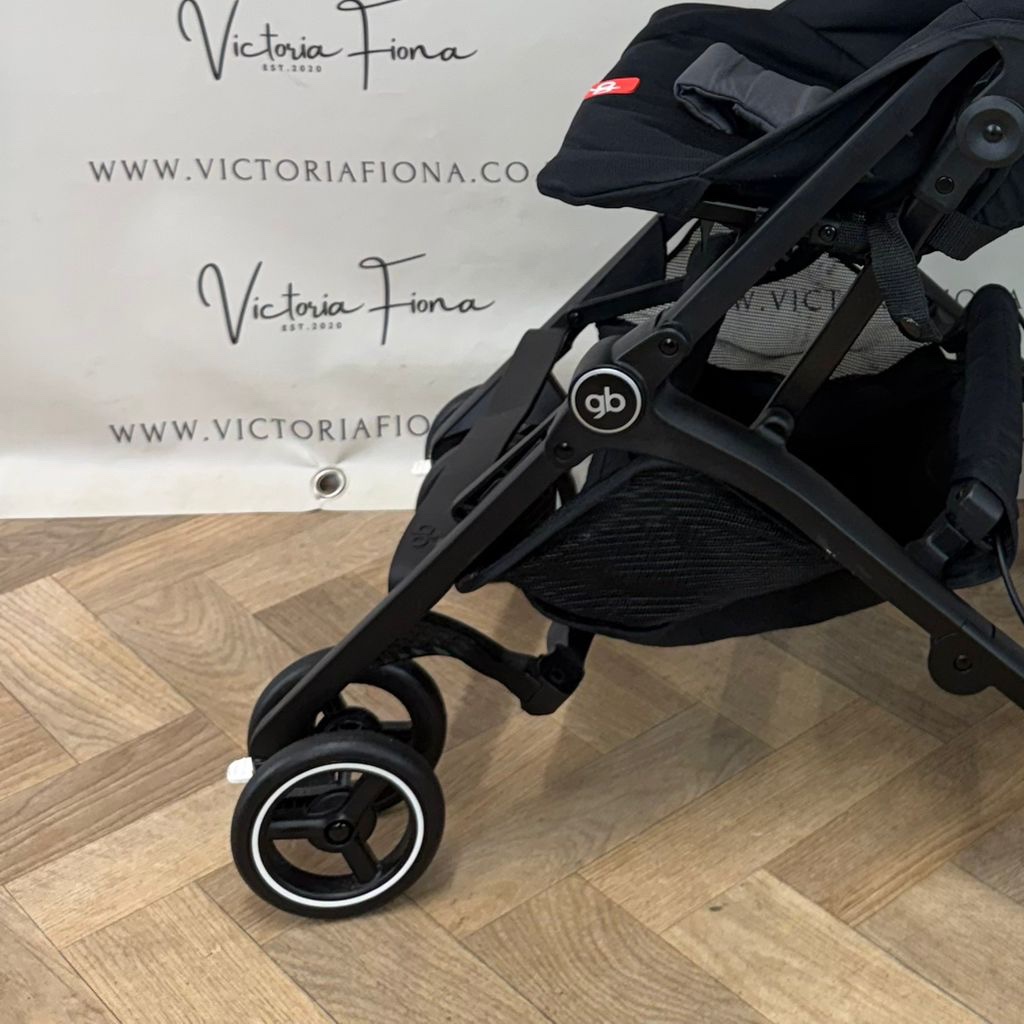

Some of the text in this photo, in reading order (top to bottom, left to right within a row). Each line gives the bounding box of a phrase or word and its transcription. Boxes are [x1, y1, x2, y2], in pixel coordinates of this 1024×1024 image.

[262, 64, 321, 72] EST.2020
[88, 158, 529, 183] WWW.VICTORIAFIONA.CO
[197, 253, 495, 346] Victoria Fiona
[281, 322, 342, 332] EST.2020
[584, 385, 627, 420] gb
